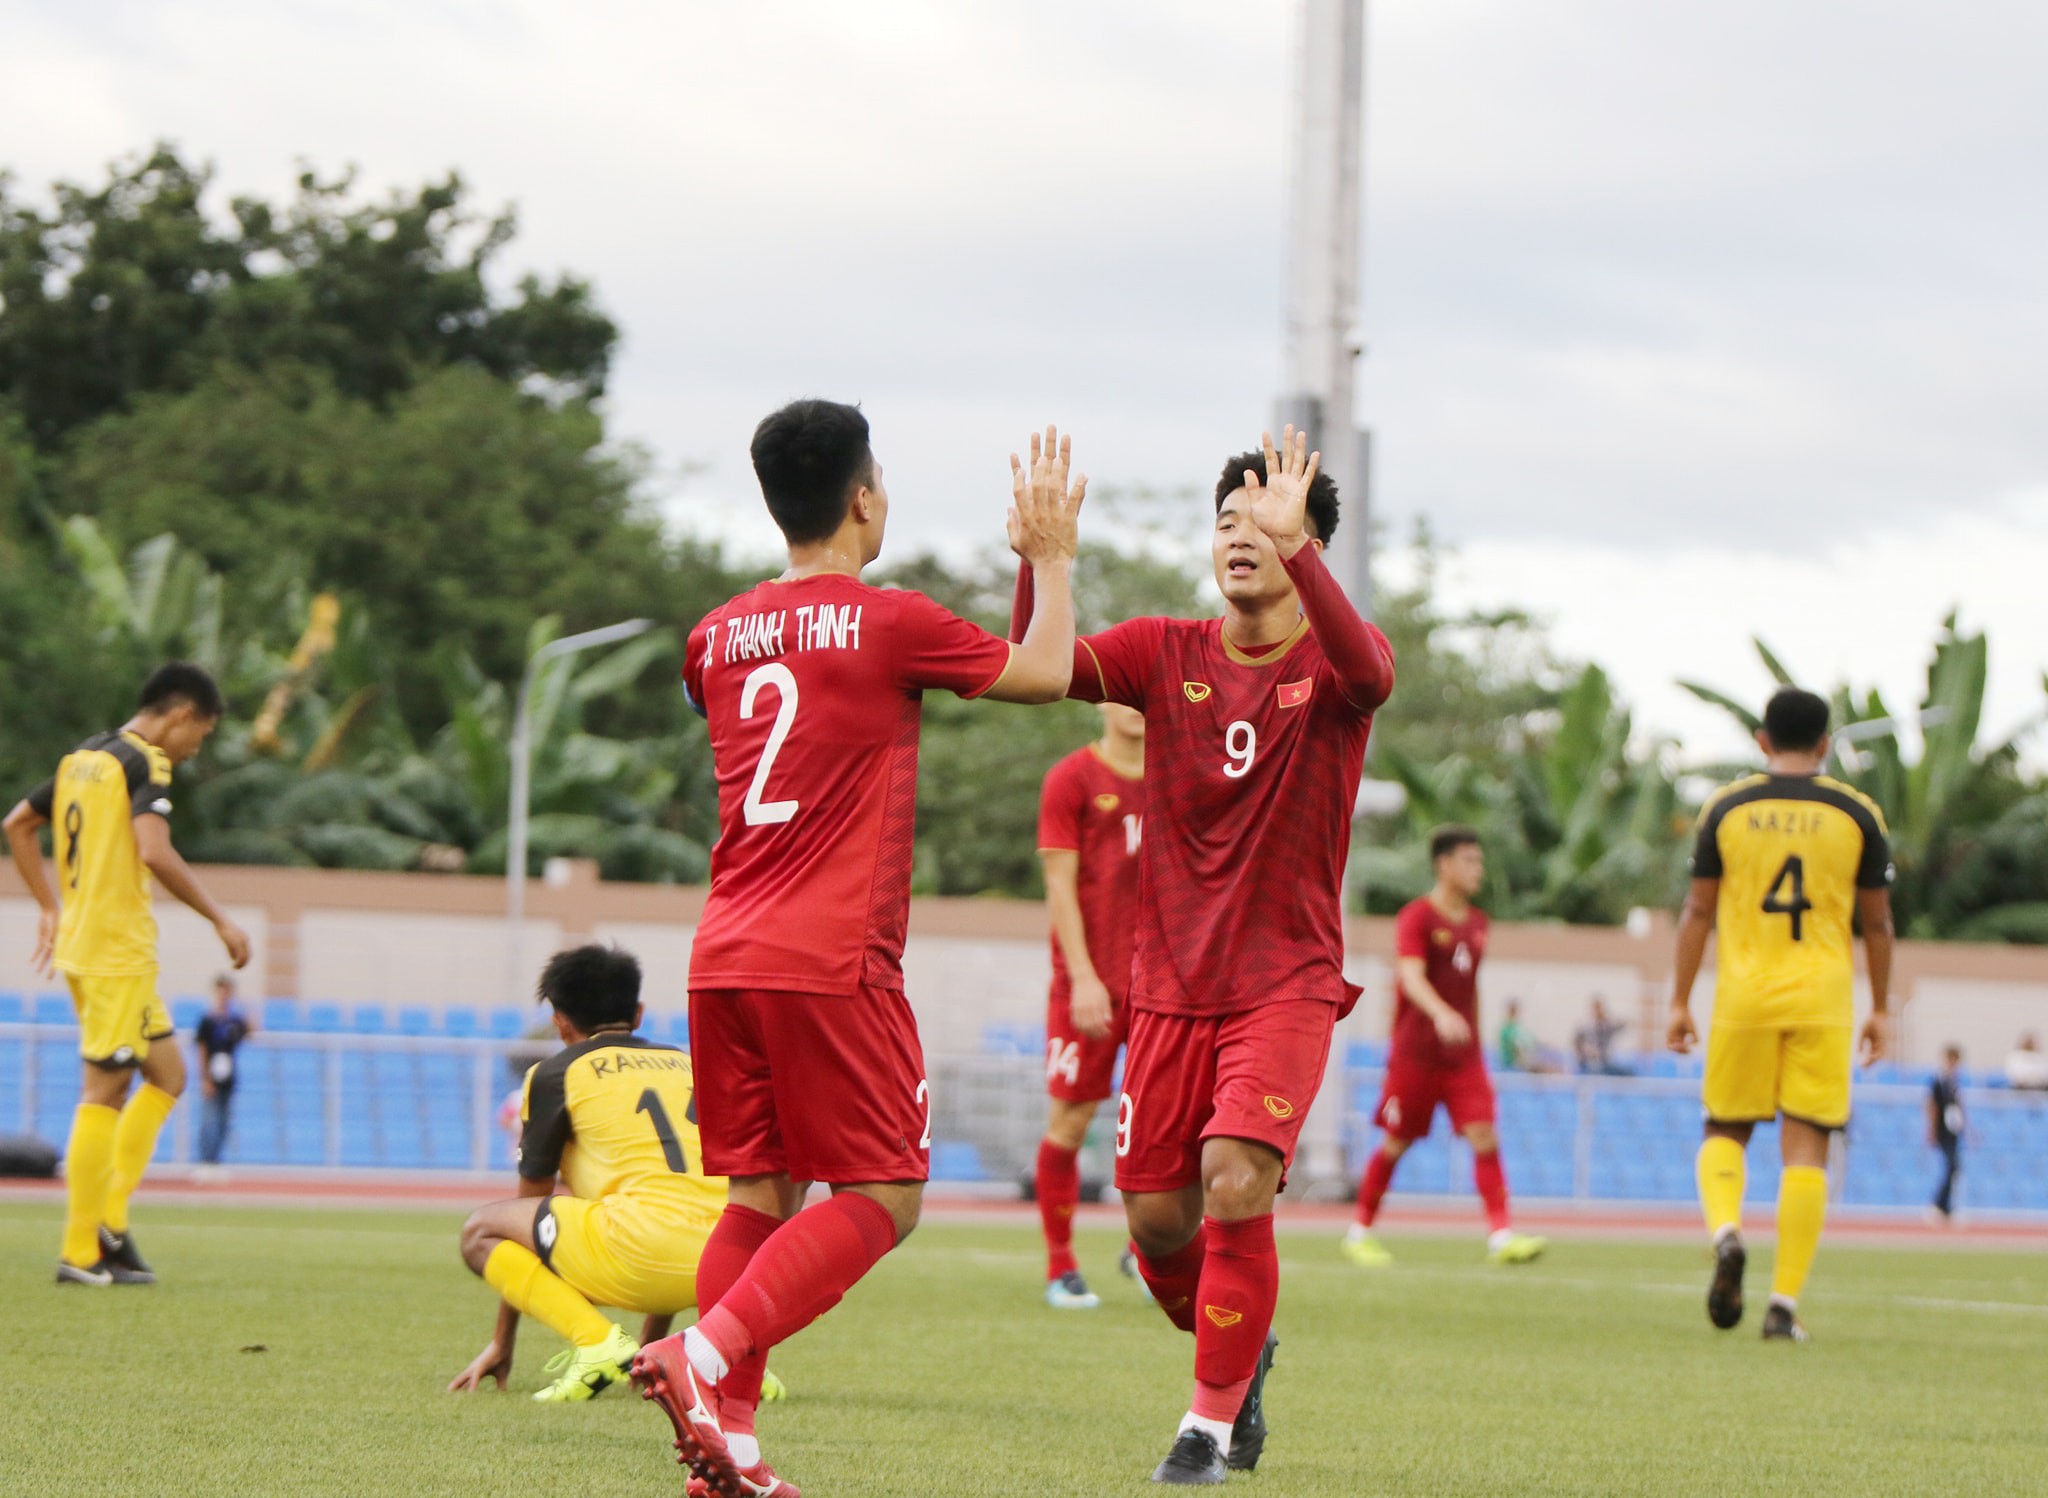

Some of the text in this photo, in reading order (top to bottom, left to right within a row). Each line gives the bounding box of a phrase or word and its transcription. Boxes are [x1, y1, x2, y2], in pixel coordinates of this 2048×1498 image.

[725, 610, 787, 663] THANH
[796, 604, 863, 652] THINH
[740, 662, 799, 826] 2
[1222, 720, 1257, 778] 9
[1746, 809, 1824, 835] NAZIF
[1761, 855, 1812, 941] 4
[1046, 1037, 1079, 1086] 14
[916, 1079, 931, 1149] 2
[1116, 1092, 1133, 1156] 9
